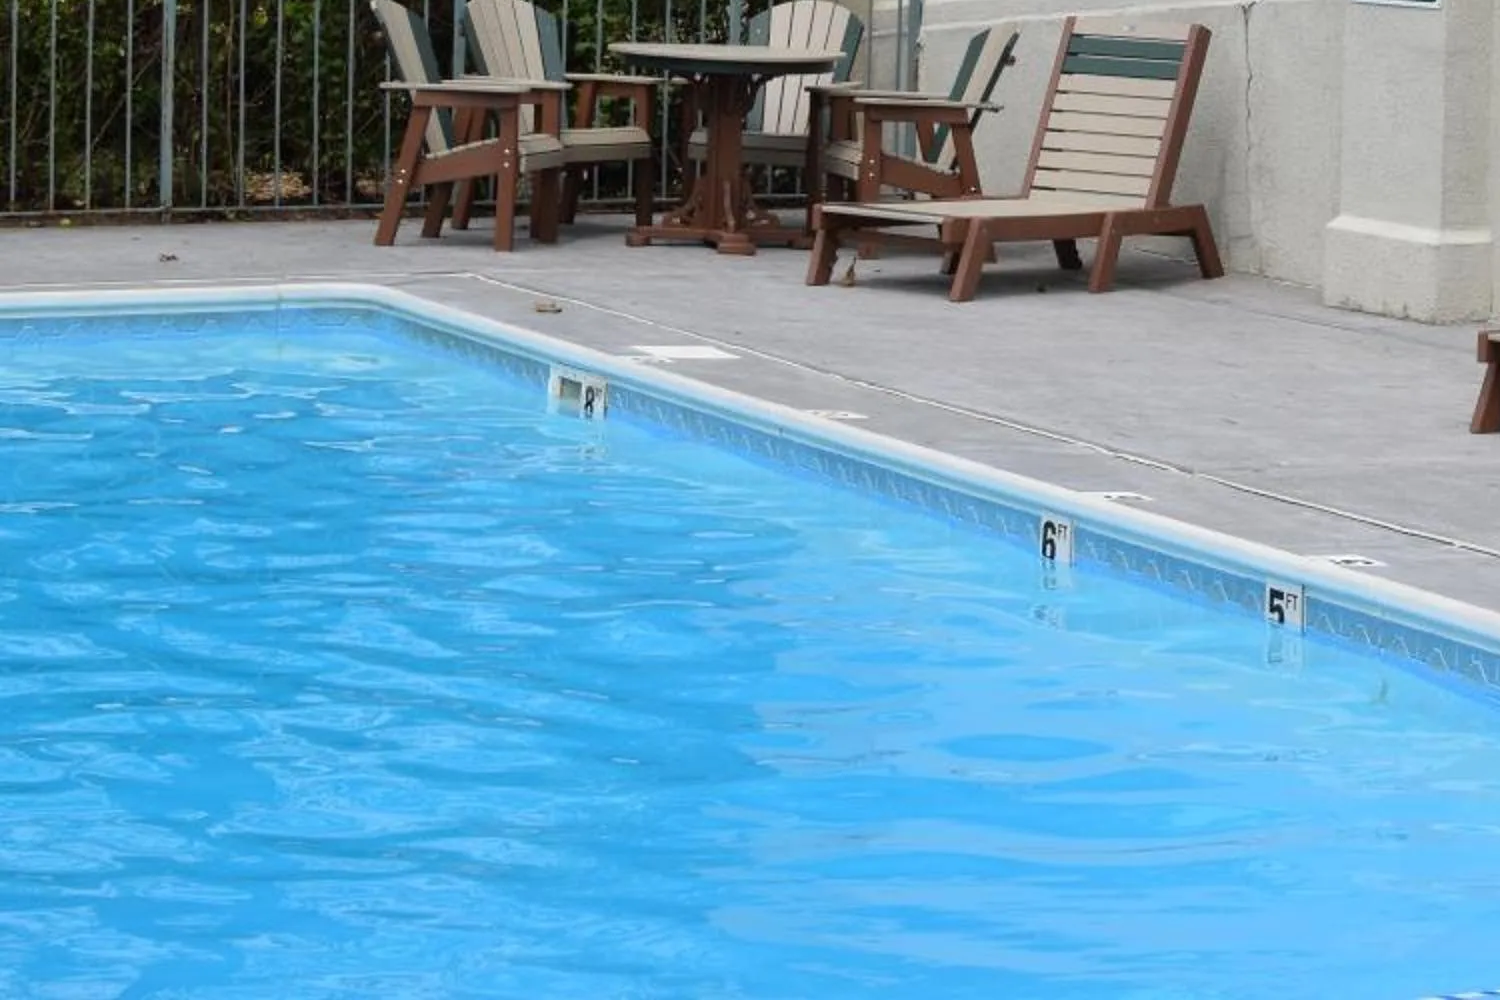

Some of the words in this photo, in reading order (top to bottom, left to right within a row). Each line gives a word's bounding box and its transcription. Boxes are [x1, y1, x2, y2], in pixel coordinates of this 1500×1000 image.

[1042, 520, 1056, 560] 6
[1058, 523, 1068, 539] FT
[1269, 587, 1285, 625] 5
[1285, 593, 1299, 611] FT
